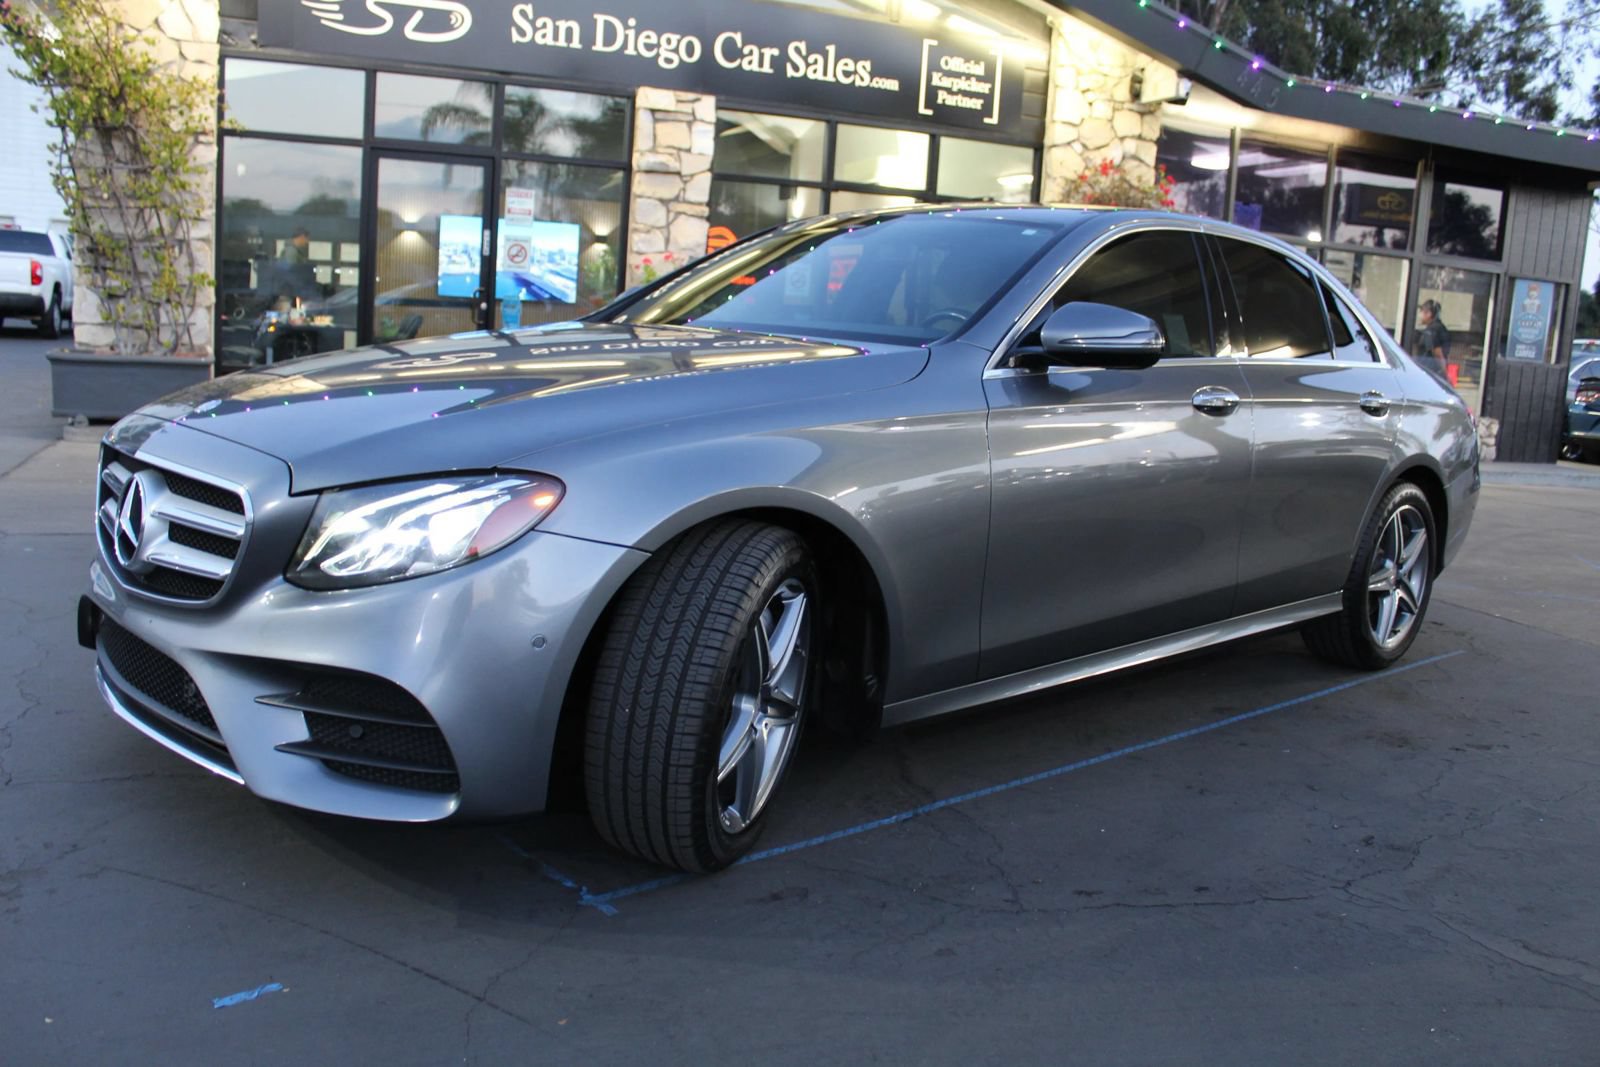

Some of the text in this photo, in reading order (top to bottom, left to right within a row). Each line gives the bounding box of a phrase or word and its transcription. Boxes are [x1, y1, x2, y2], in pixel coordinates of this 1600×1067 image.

[511, 3, 583, 49] San
[591, 13, 702, 70] Diego
[713, 31, 780, 74] Car
[939, 55, 985, 76] Official
[936, 89, 984, 110] Partner
